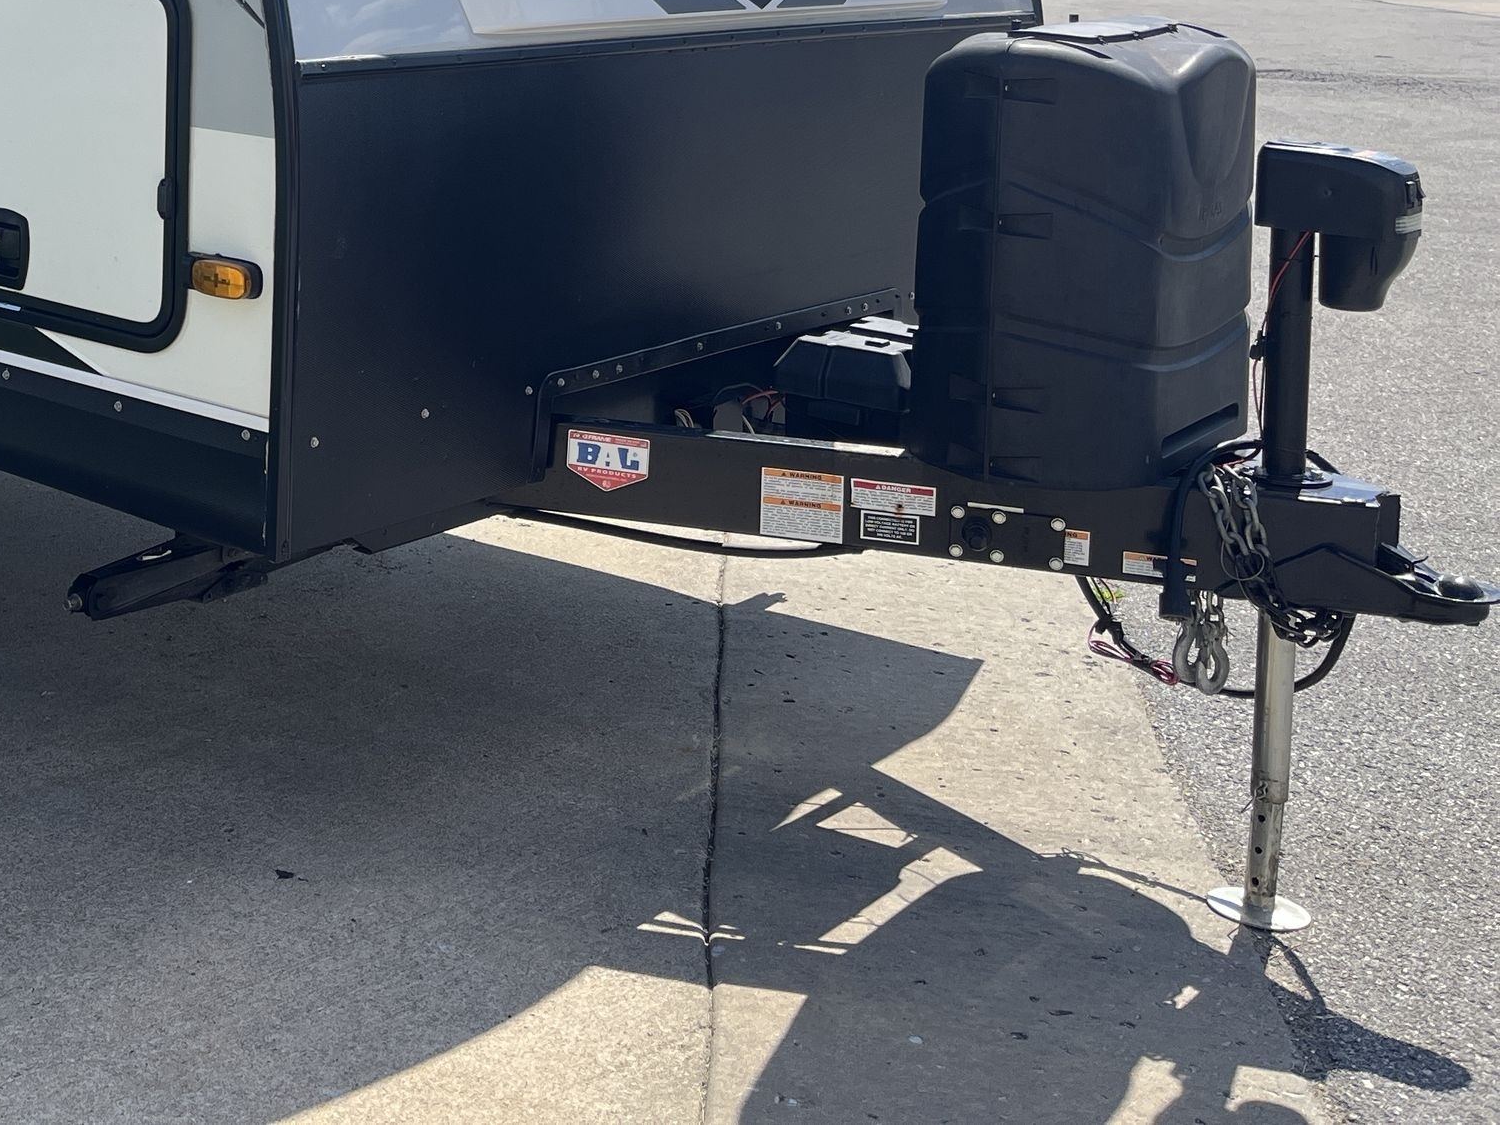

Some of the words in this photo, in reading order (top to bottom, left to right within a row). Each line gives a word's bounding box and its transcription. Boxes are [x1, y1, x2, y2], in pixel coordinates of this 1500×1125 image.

[576, 441, 640, 471] BAL
[591, 468, 637, 479] PRODUCTS
[790, 472, 822, 481] WARNING
[881, 485, 912, 493] DANGER
[789, 500, 822, 509] WARNING
